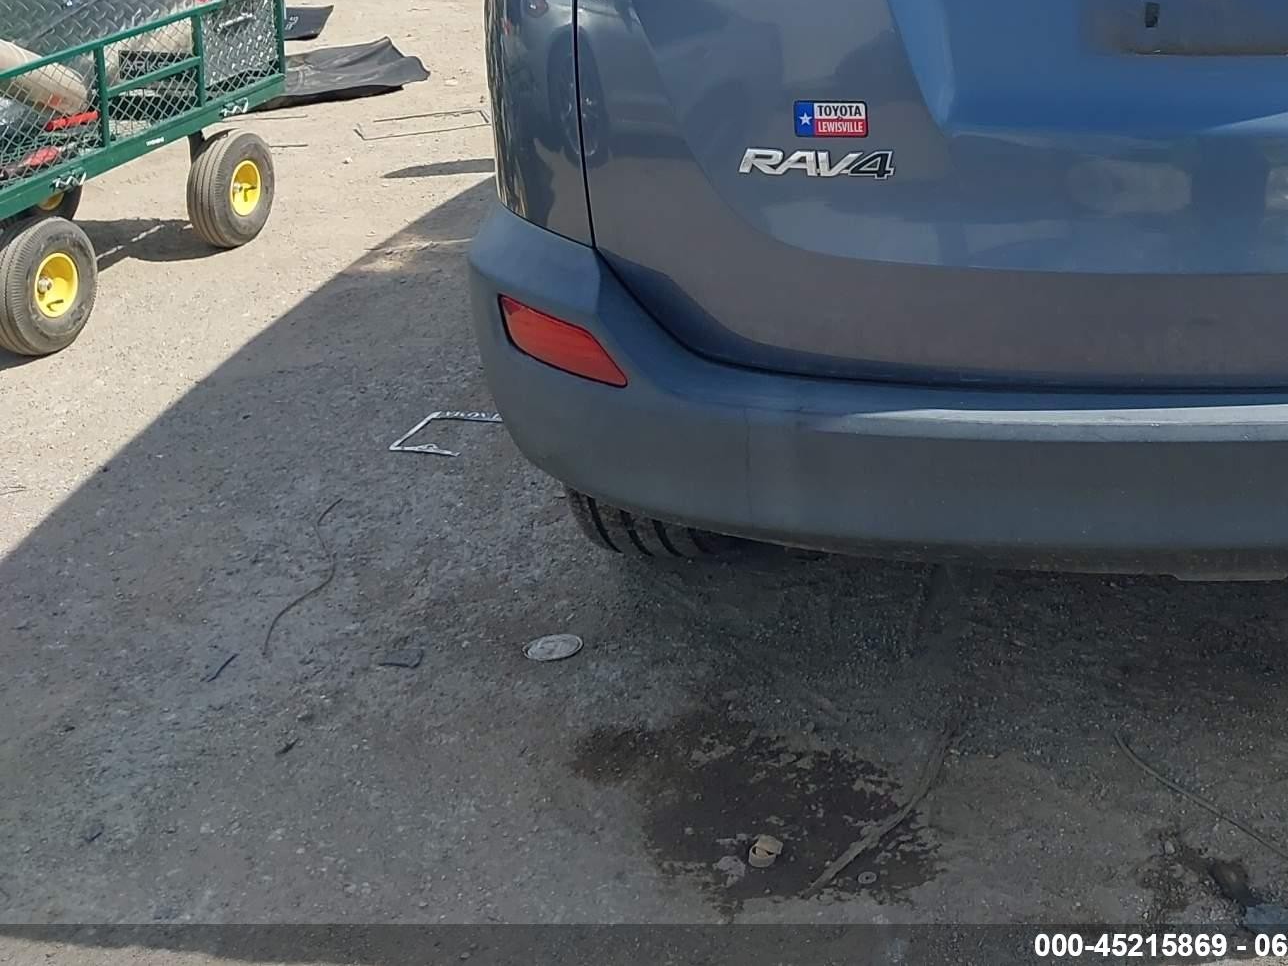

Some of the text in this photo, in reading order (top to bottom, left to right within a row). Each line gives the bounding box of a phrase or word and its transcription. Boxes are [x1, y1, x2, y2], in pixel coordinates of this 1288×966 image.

[817, 104, 862, 117] TOYOTA
[818, 121, 864, 133] LEWISVILLE
[738, 147, 896, 180] RAV4
